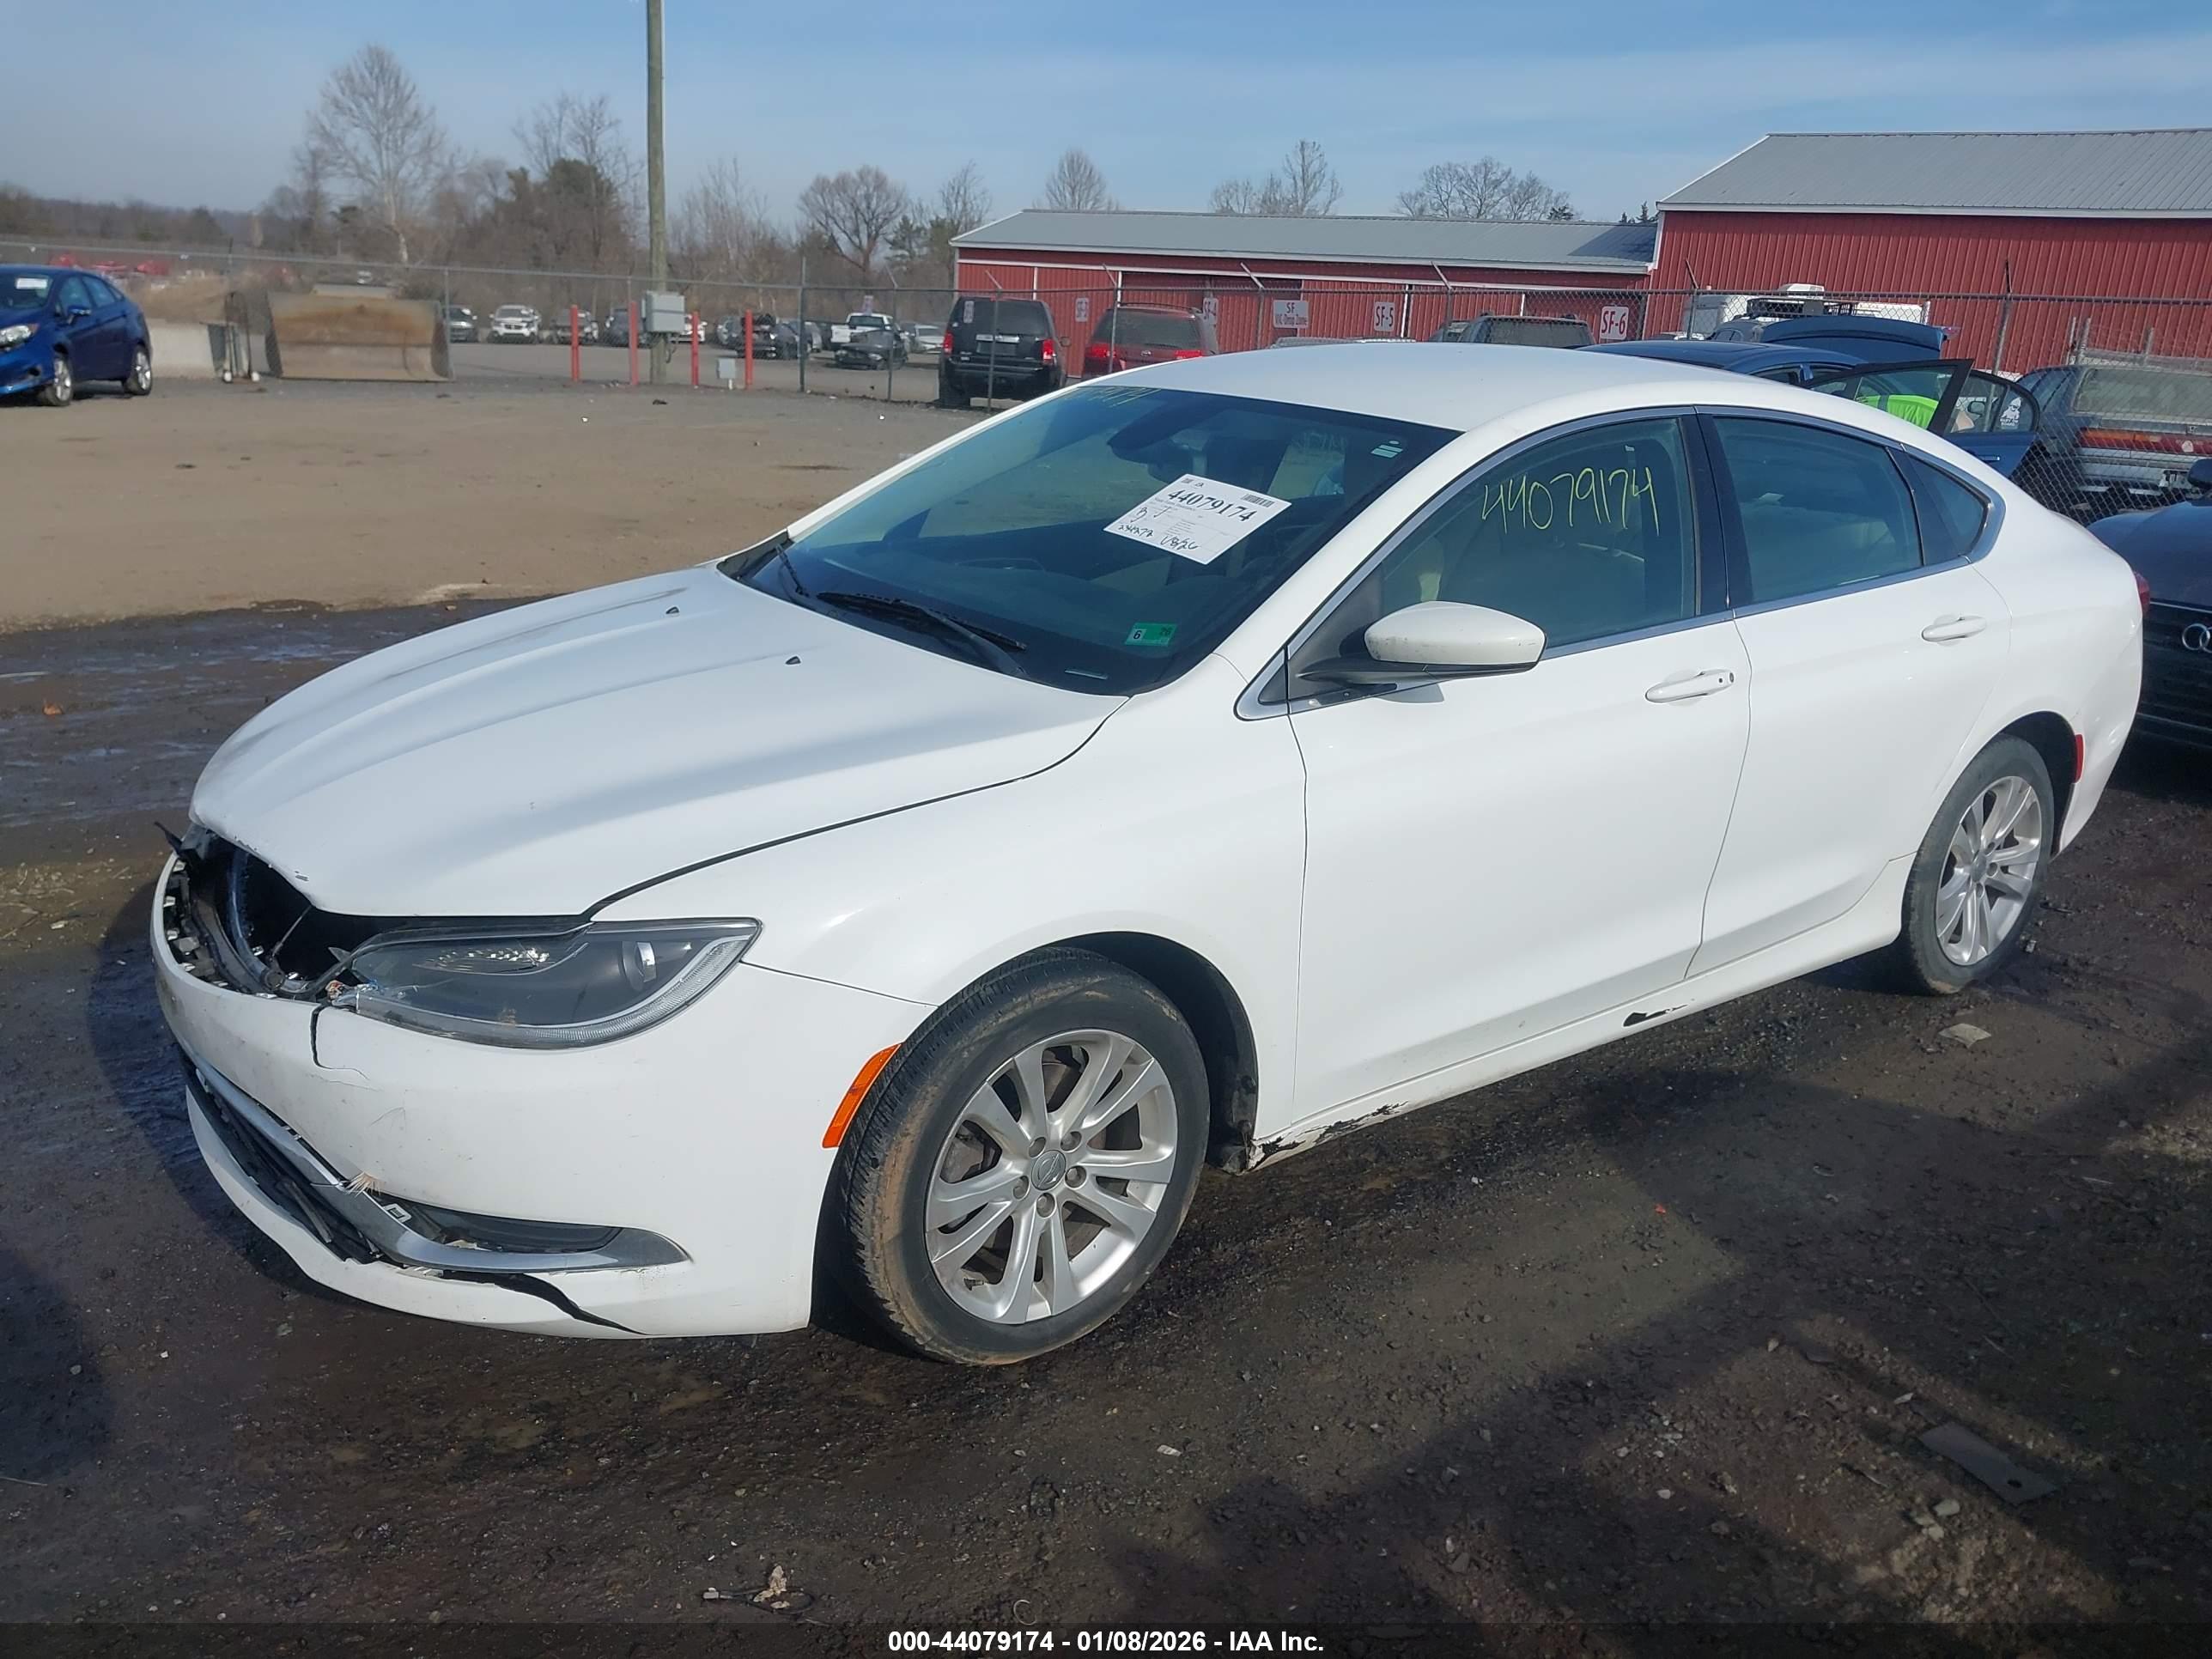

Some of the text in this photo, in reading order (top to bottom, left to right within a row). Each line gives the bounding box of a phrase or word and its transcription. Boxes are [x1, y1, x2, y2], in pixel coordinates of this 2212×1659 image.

[1286, 301, 1296, 314] SF
[1376, 306, 1394, 327] SF-5
[1601, 310, 1626, 335] SF-6
[1168, 489, 1257, 522] 44079174
[1481, 466, 1659, 537] 44079174
[1133, 629, 1142, 640] 6
